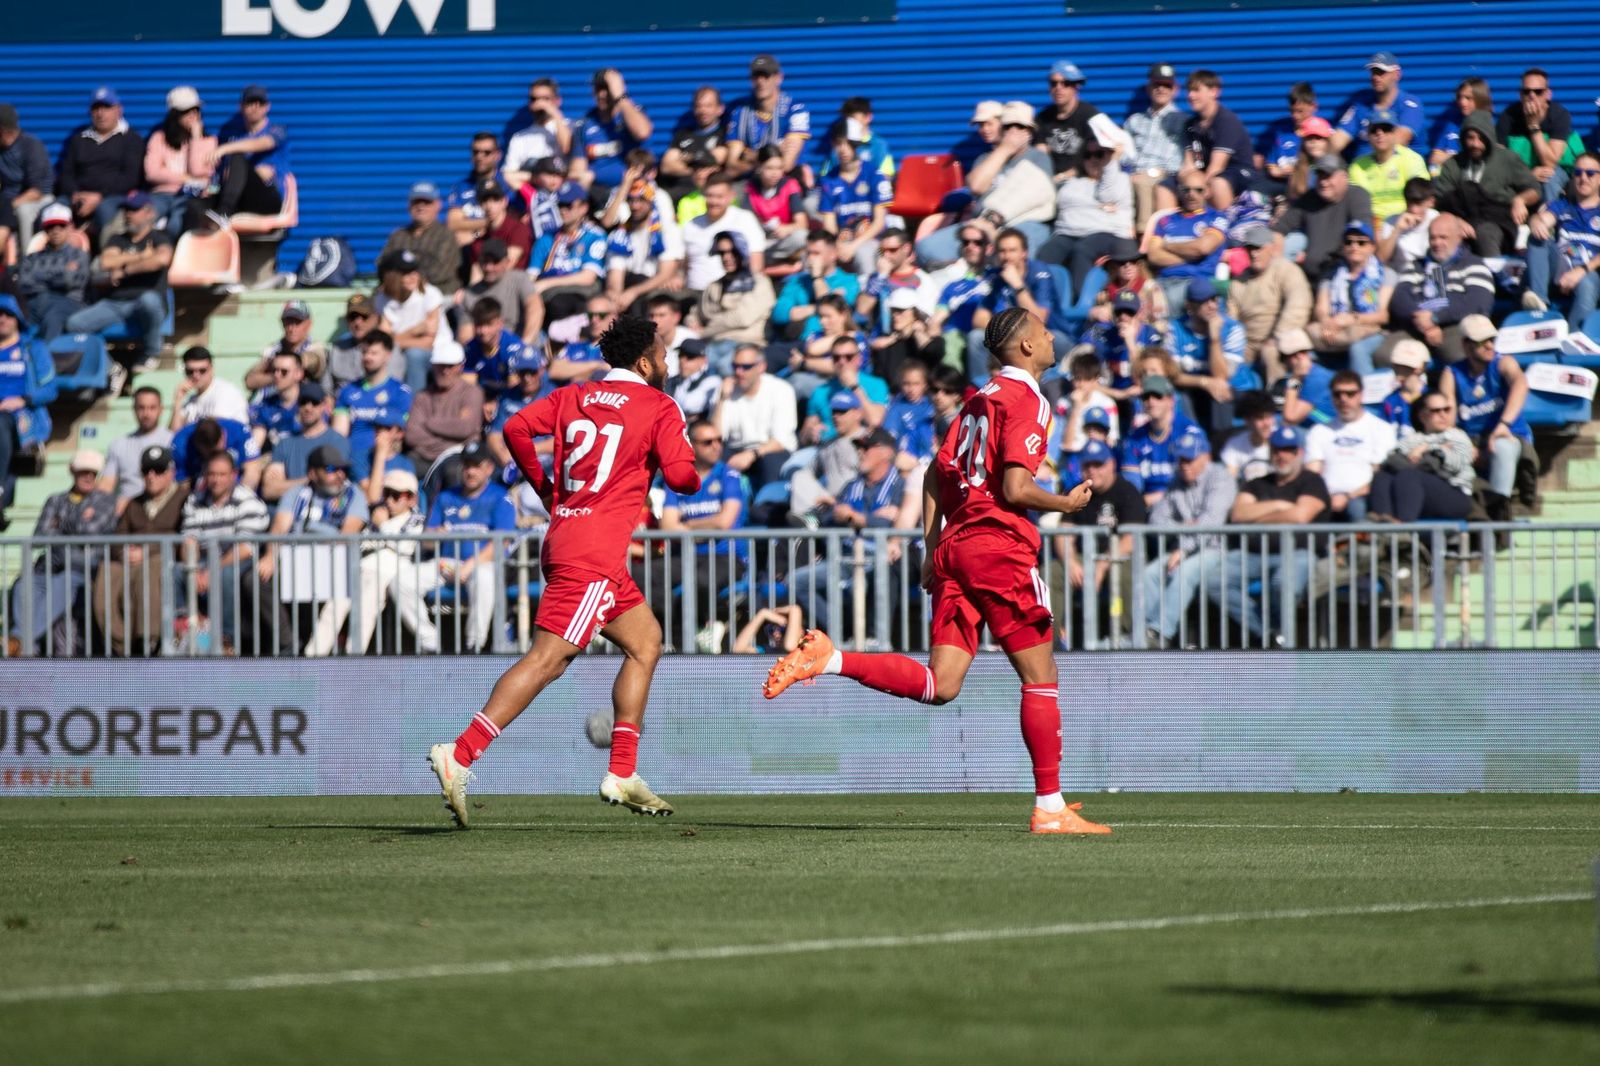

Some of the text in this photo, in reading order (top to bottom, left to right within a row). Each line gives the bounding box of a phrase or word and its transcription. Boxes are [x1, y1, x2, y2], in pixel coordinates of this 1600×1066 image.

[583, 391, 630, 409] EJUKE
[564, 419, 624, 493] 21
[0, 706, 307, 756] ROREPAR
